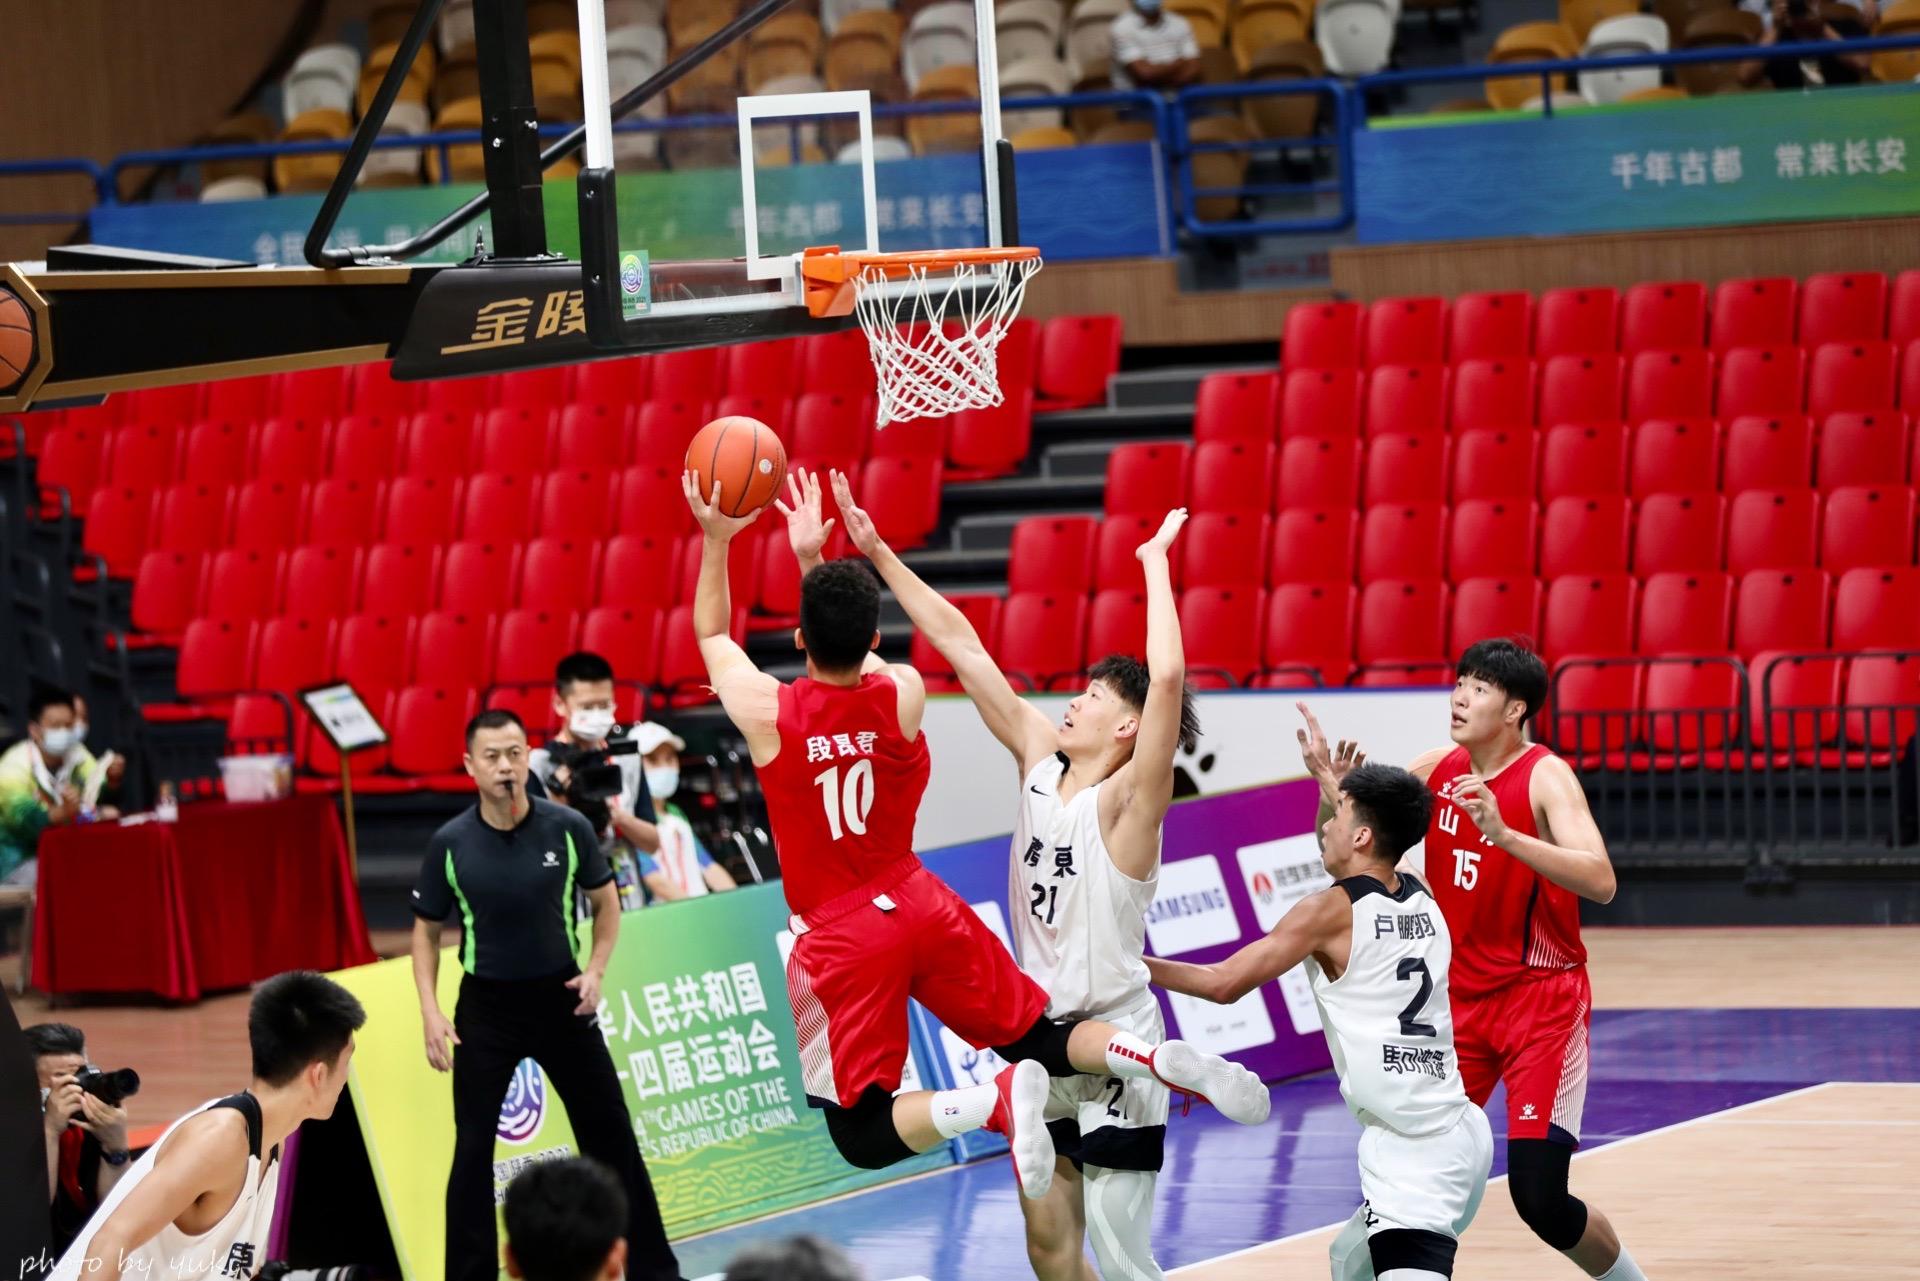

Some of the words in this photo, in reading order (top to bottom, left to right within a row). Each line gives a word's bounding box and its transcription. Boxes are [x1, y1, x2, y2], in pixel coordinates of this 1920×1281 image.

[1612, 147, 1742, 188] 千年古都
[1775, 137, 1906, 178] 常来长安
[814, 758, 875, 841] 10
[1438, 804, 1460, 836] 山
[1452, 848, 1482, 891] 15
[1030, 882, 1058, 925] 21
[1147, 888, 1226, 924] SAMSUNG
[1396, 957, 1437, 1037] 2
[655, 1091, 726, 1133] GAMES
[723, 1082, 759, 1114] OF
[750, 1076, 792, 1108] THE
[659, 1120, 737, 1156] REPUBLIC
[730, 1115, 760, 1140] OF
[749, 1104, 798, 1134] CHINA
